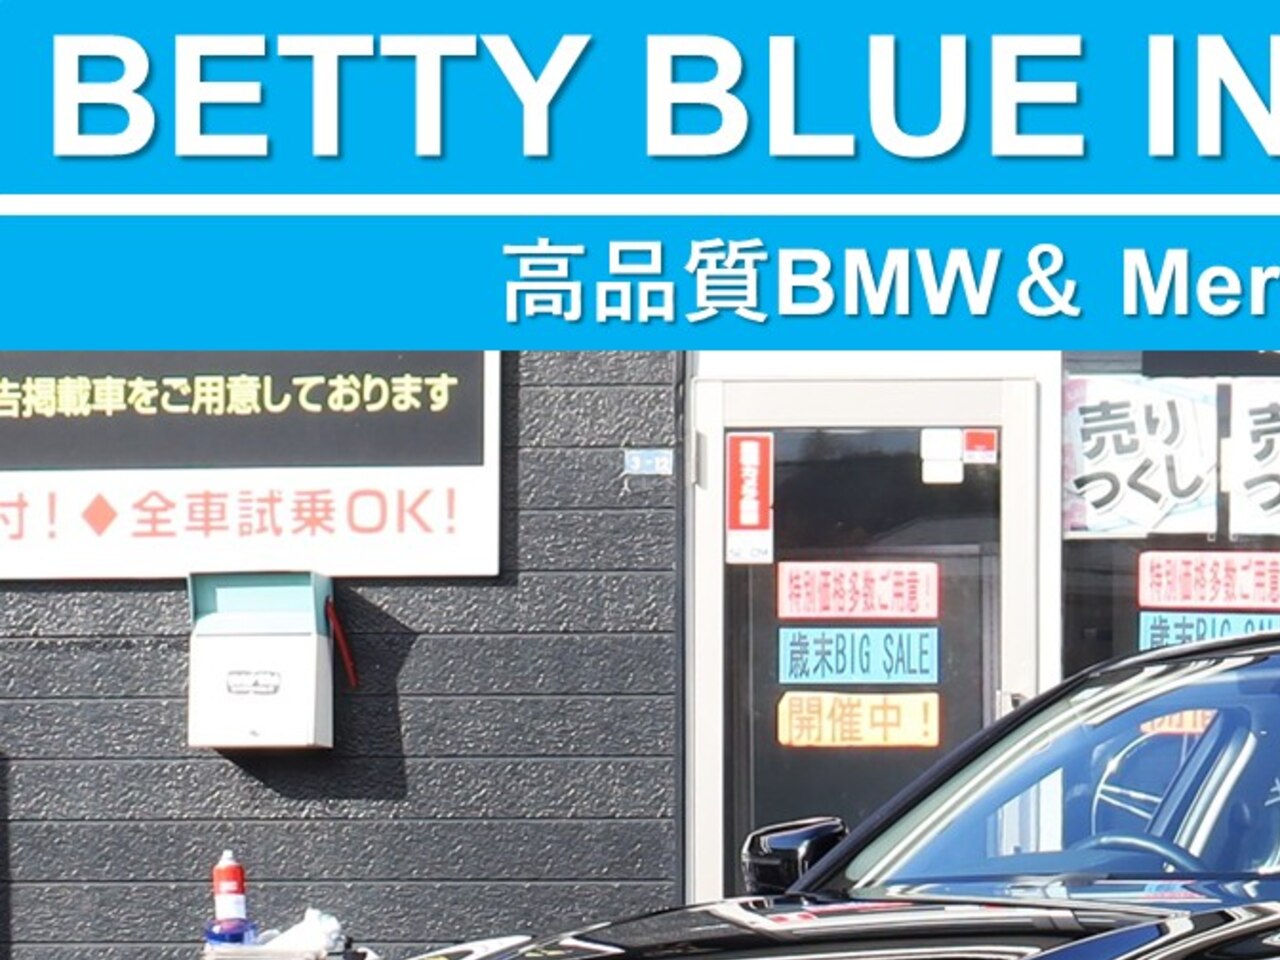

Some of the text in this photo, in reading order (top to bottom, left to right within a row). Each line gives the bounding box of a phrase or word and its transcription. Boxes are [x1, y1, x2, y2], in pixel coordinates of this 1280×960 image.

[1078, 400, 1181, 460] 売り
[1073, 454, 1204, 510] つくし
[789, 631, 930, 679] 歳末BIG SALE
